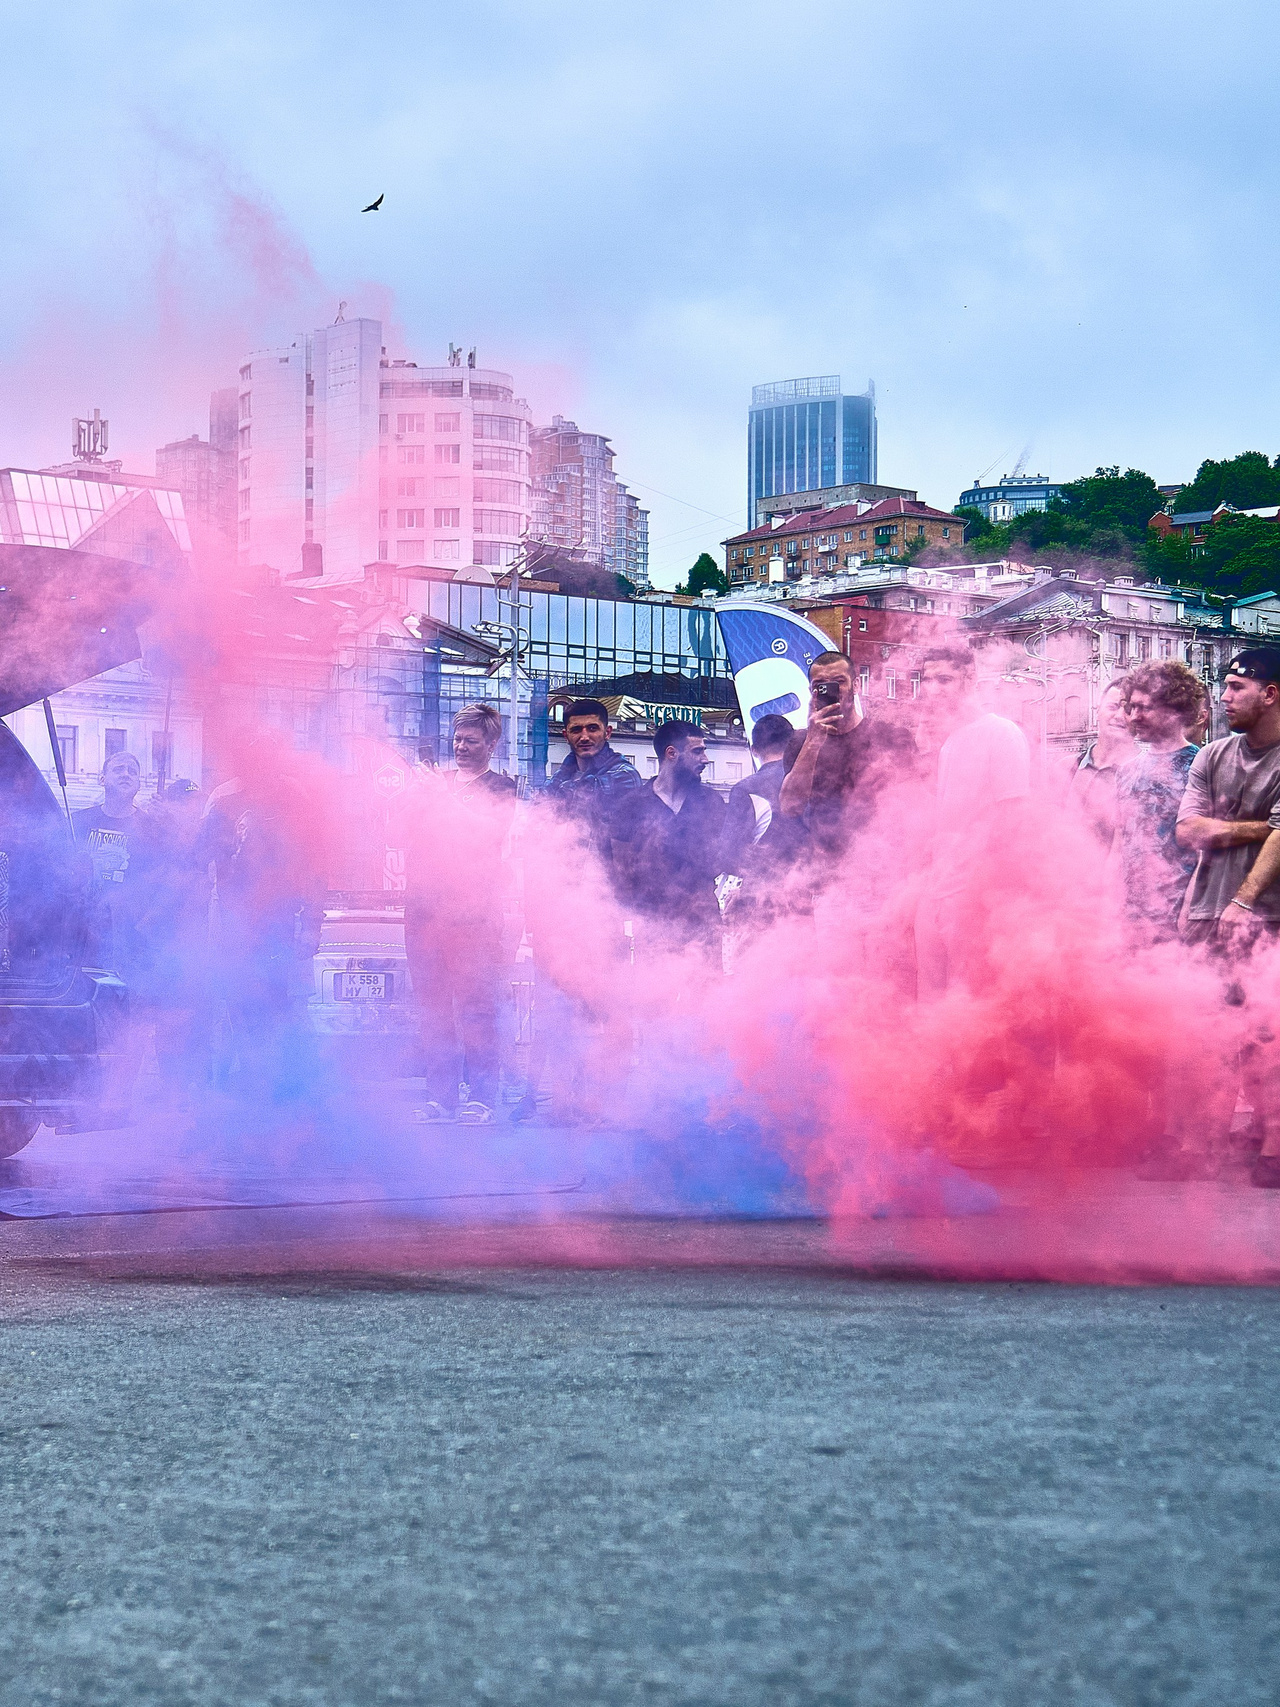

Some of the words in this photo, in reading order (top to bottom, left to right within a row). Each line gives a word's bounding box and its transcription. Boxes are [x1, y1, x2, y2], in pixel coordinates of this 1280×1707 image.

[348, 975, 356, 985] К
[359, 975, 379, 985] 558
[345, 987, 361, 997] МУ
[371, 987, 382, 995] 27
